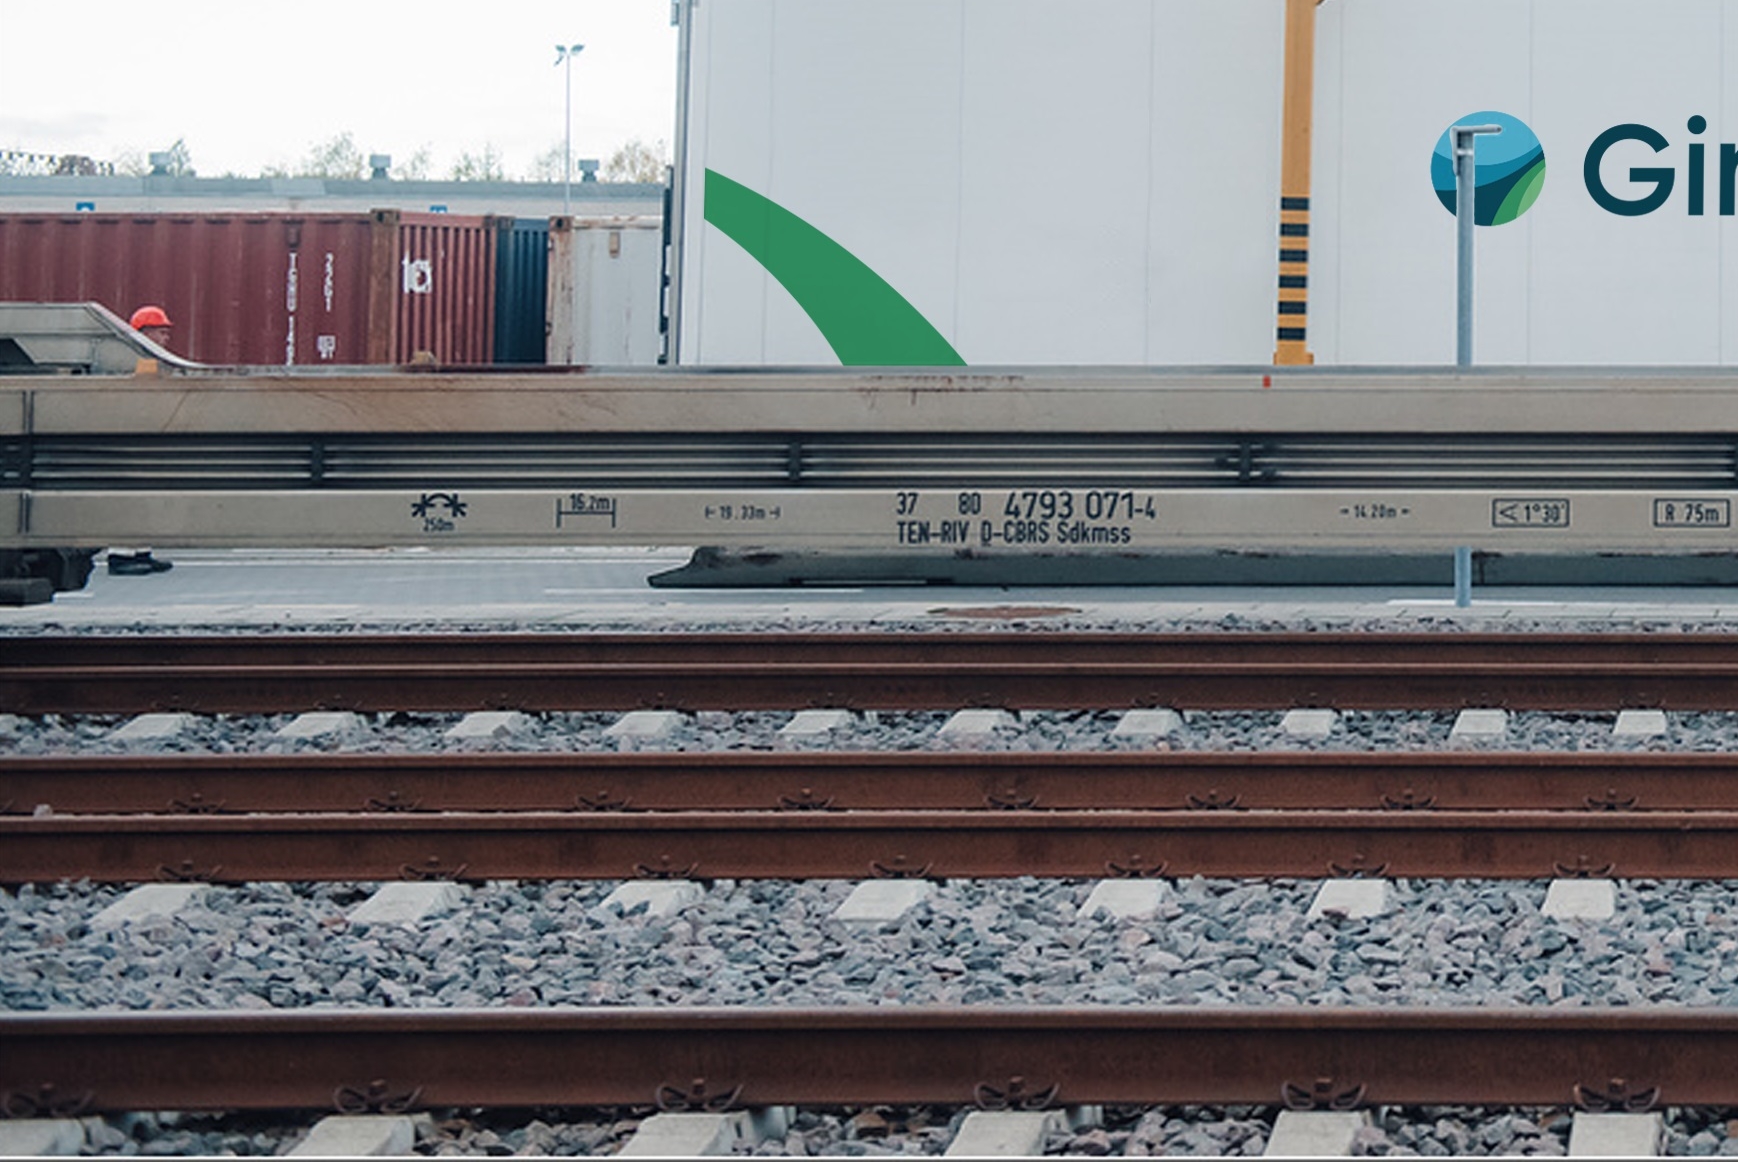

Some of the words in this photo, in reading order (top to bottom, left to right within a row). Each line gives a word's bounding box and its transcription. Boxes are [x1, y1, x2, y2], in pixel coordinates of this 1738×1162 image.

[896, 492, 919, 516] 37
[958, 492, 982, 516] 80
[1004, 492, 1074, 520] 4793
[1085, 492, 1156, 520] 071-4
[1685, 503, 1719, 522] 75m
[897, 520, 970, 544] TEN-RIV
[980, 520, 1050, 546] D-CBRS
[1057, 520, 1131, 544] Sdkmss
